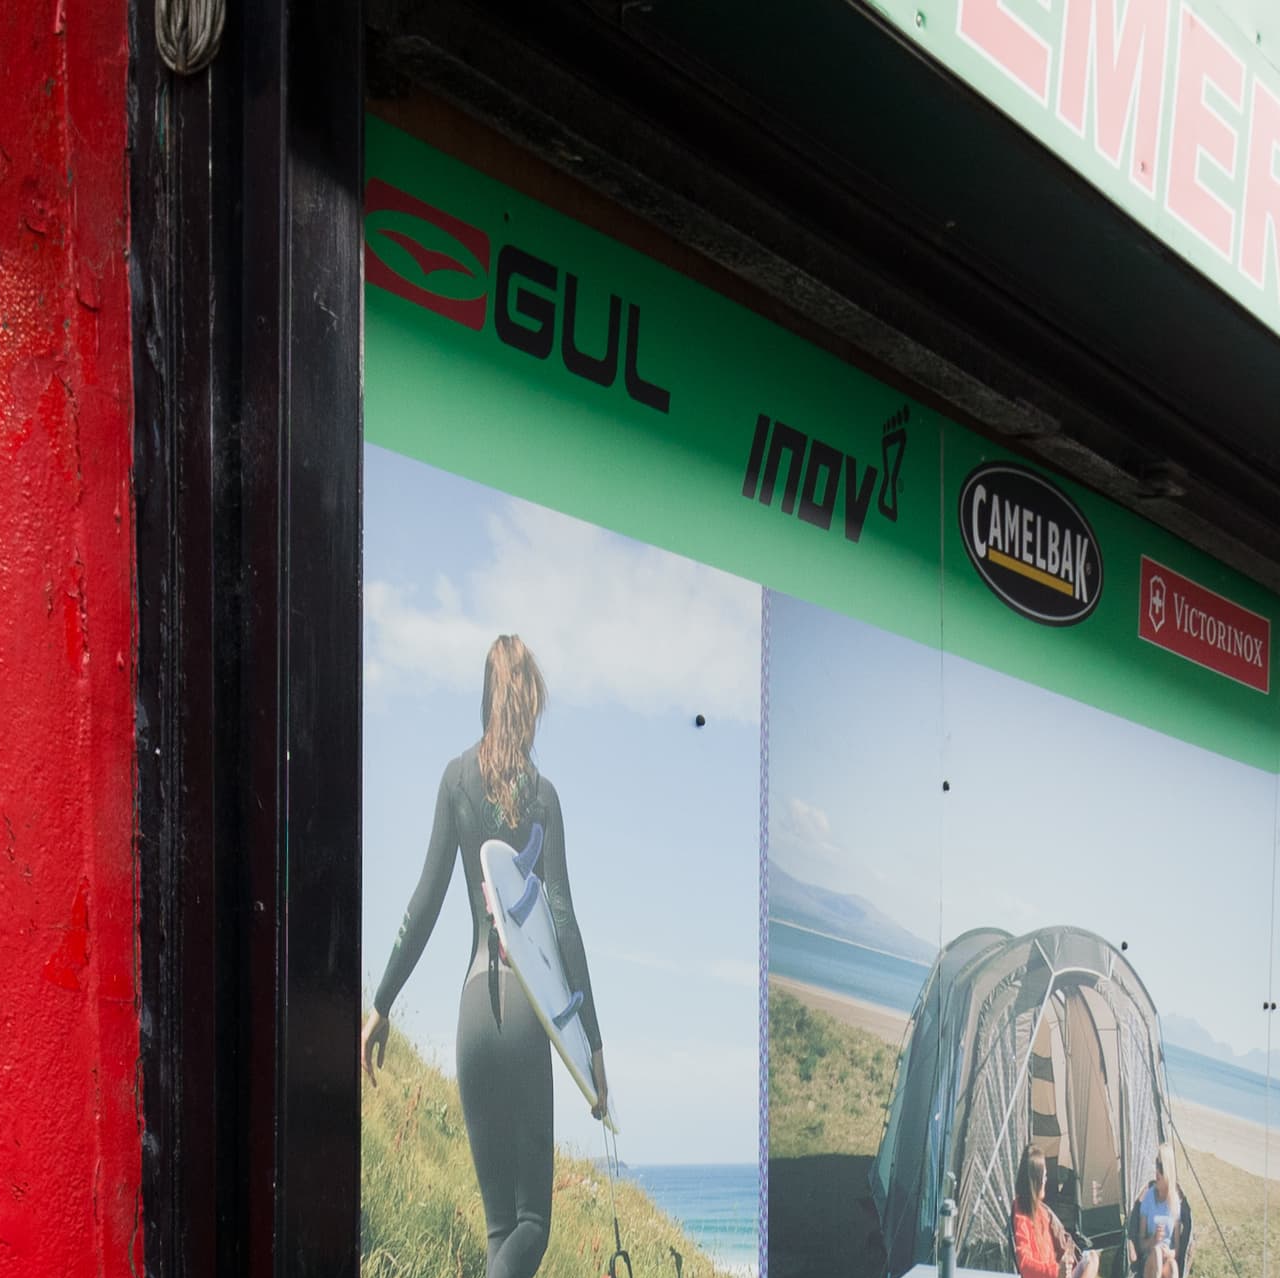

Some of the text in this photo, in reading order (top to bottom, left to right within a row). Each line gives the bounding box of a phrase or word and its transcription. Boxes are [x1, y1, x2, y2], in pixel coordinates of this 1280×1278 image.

[494, 244, 671, 415] GUL
[972, 484, 1089, 604] CAMELBAK
[1173, 591, 1264, 669] VICTORINOX
